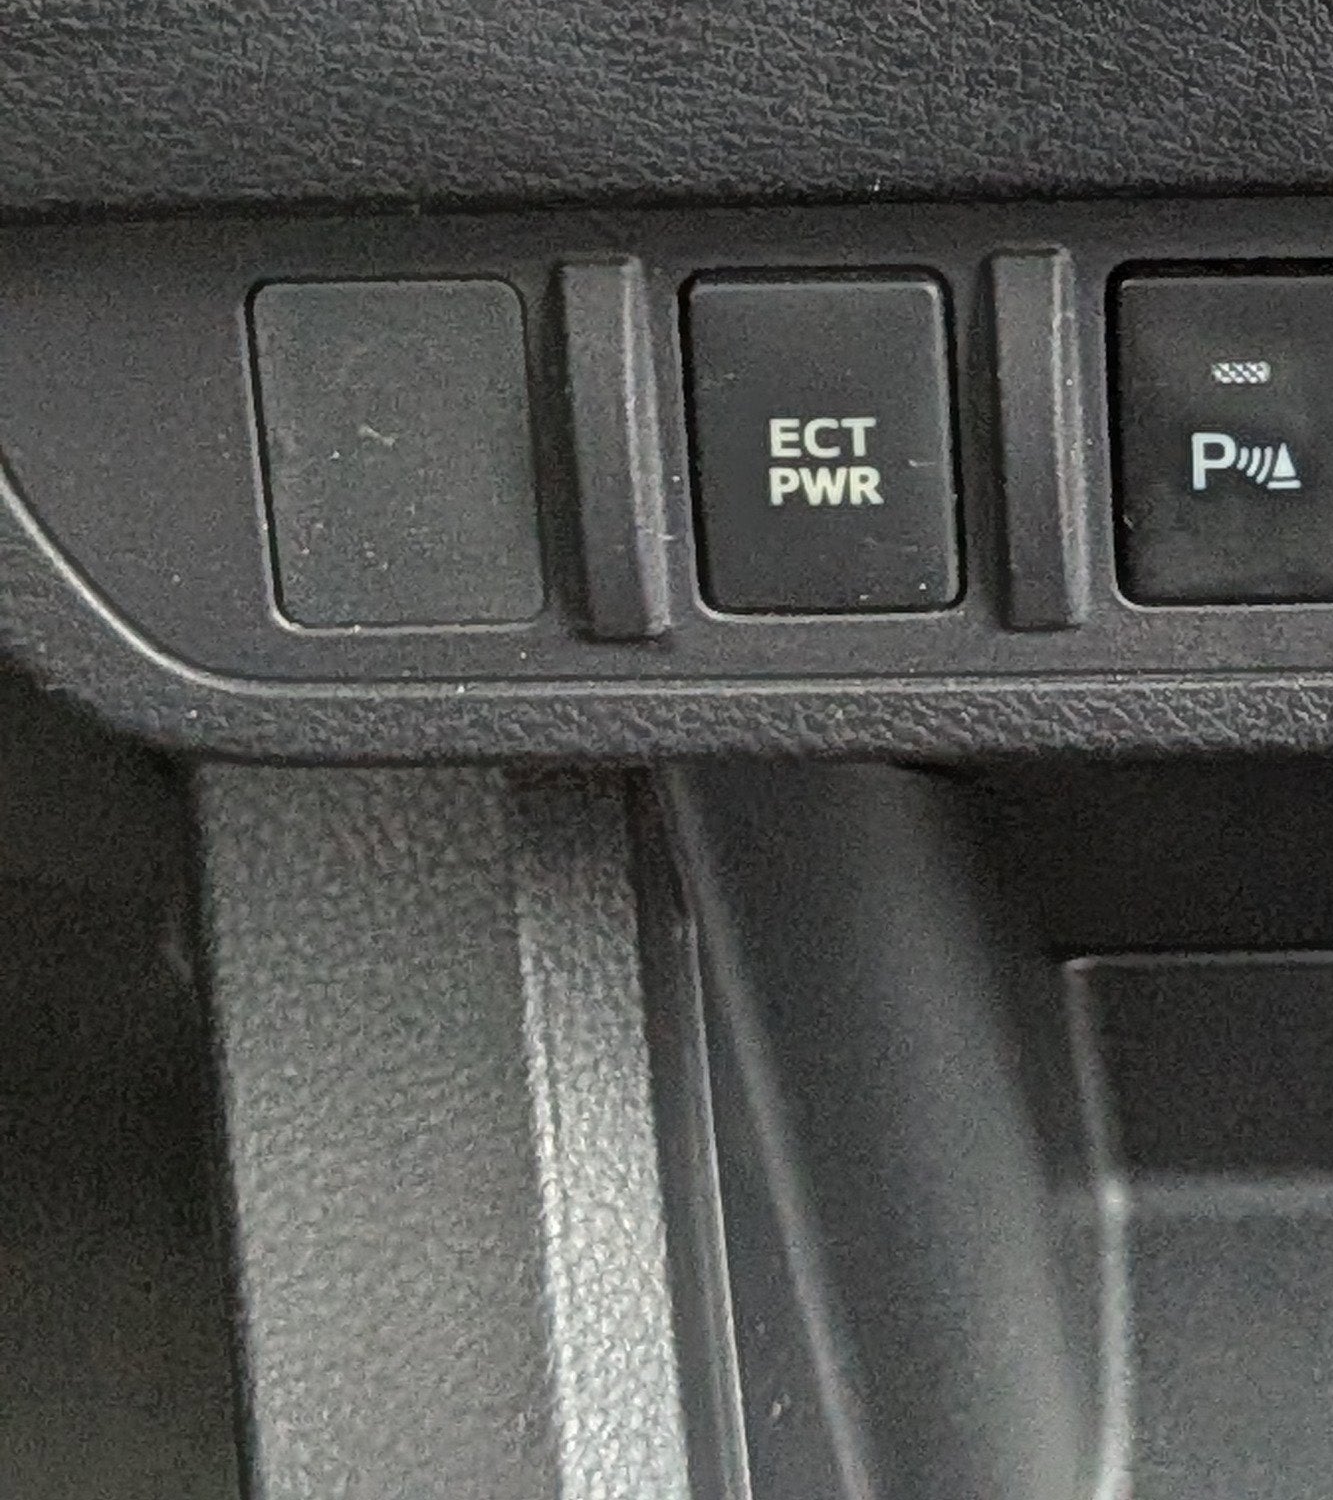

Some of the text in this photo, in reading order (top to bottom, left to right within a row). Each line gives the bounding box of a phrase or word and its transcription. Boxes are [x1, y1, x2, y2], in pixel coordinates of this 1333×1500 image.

[768, 417, 877, 459] ECT
[1191, 432, 1238, 490] P
[768, 466, 884, 506] PWR
